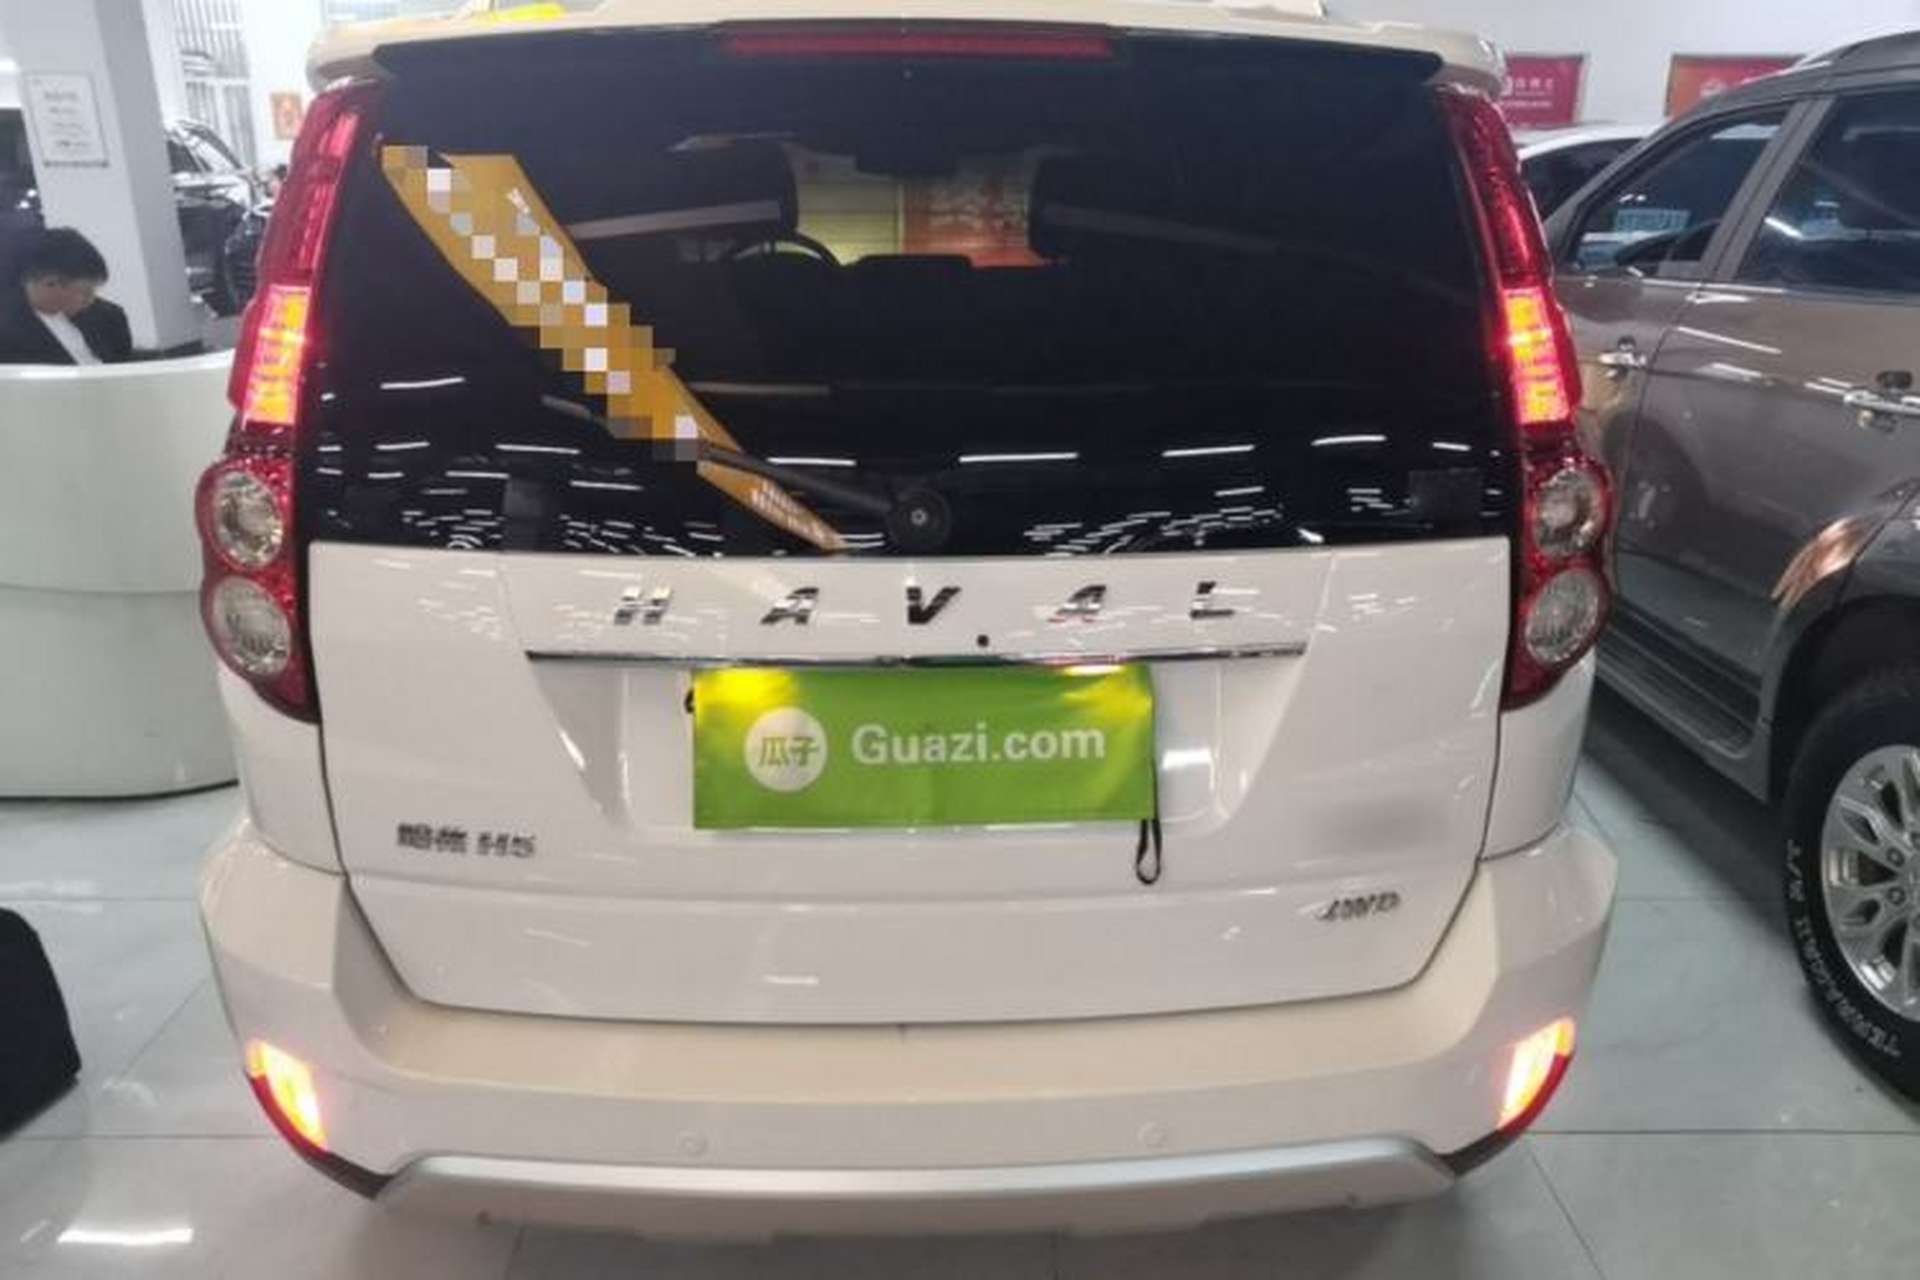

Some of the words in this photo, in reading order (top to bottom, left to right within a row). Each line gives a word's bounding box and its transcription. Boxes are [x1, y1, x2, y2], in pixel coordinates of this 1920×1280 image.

[613, 581, 1236, 626] HAVAL
[758, 734, 820, 768] 瓜子
[851, 722, 1106, 765] Guazi.com
[476, 831, 535, 858] H5
